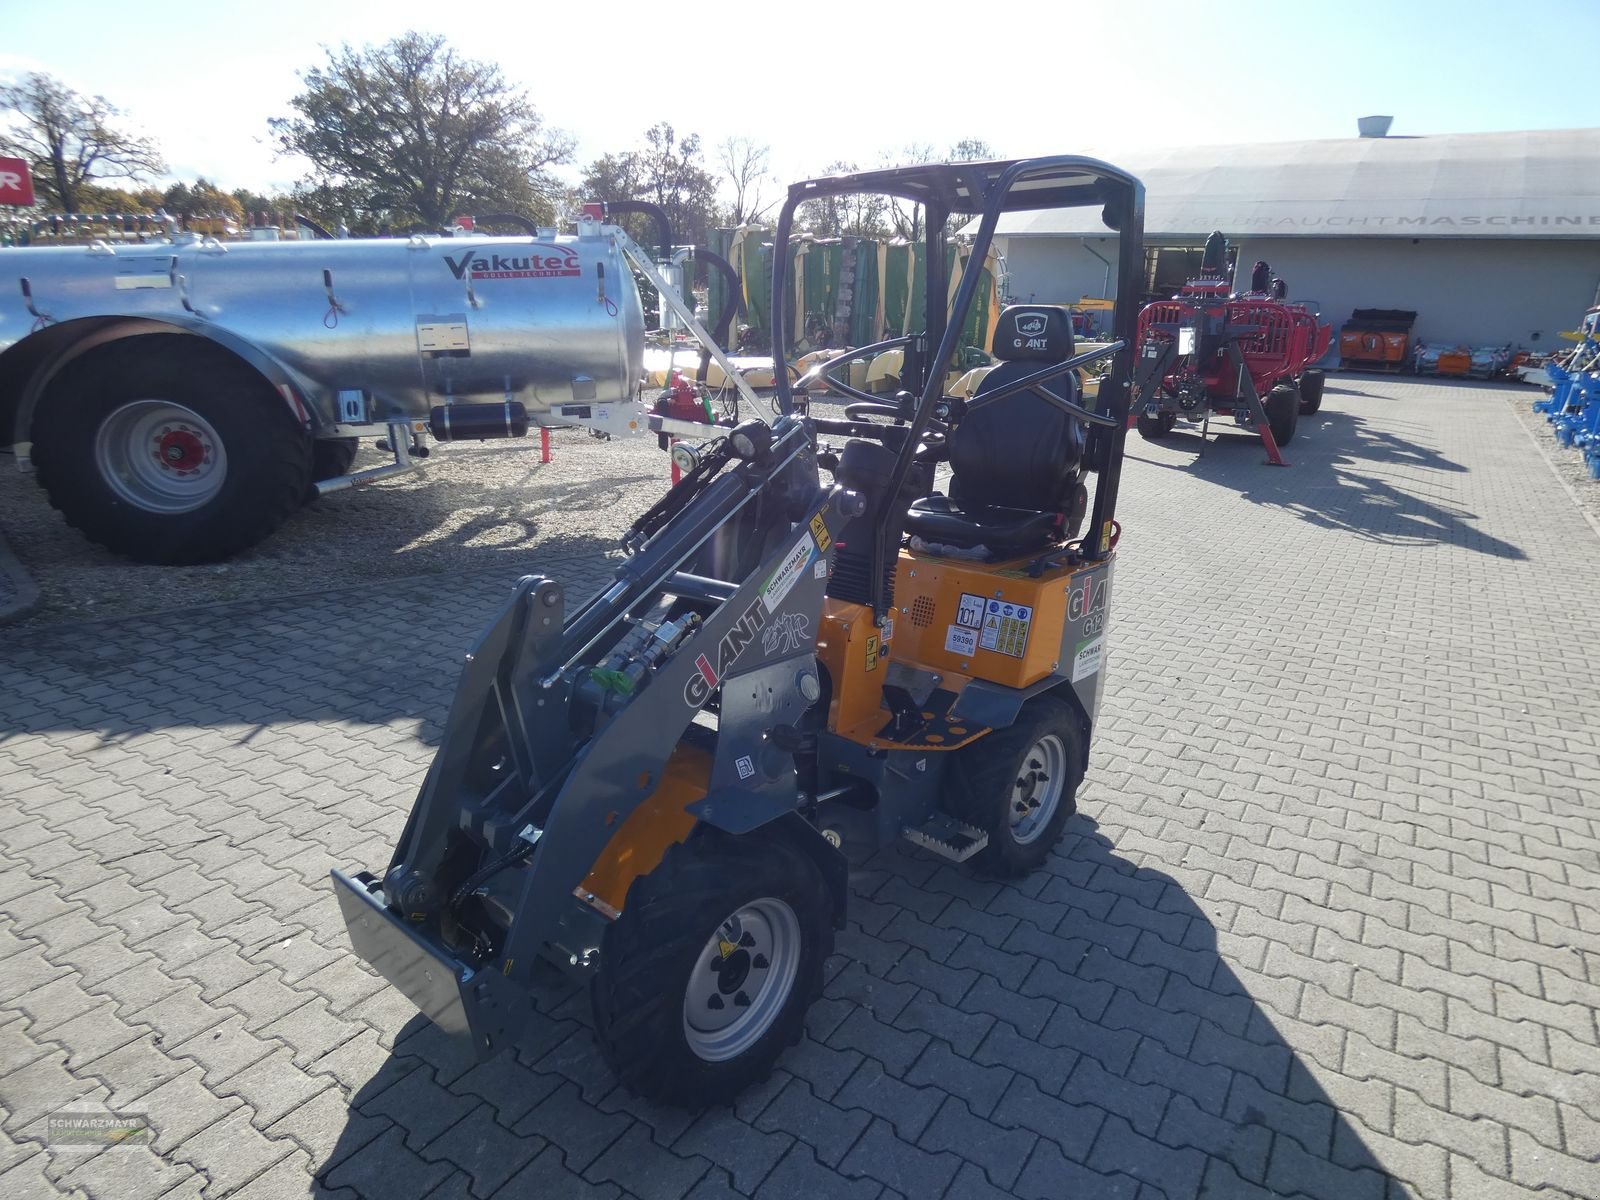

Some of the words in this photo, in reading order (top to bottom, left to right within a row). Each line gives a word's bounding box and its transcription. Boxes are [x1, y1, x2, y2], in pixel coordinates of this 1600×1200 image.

[443, 250, 581, 281] Vakutec
[766, 545, 807, 595] SCHWARZMAYR
[959, 607, 976, 626] 101
[684, 597, 766, 708] GIANT
[952, 634, 974, 646] 59390
